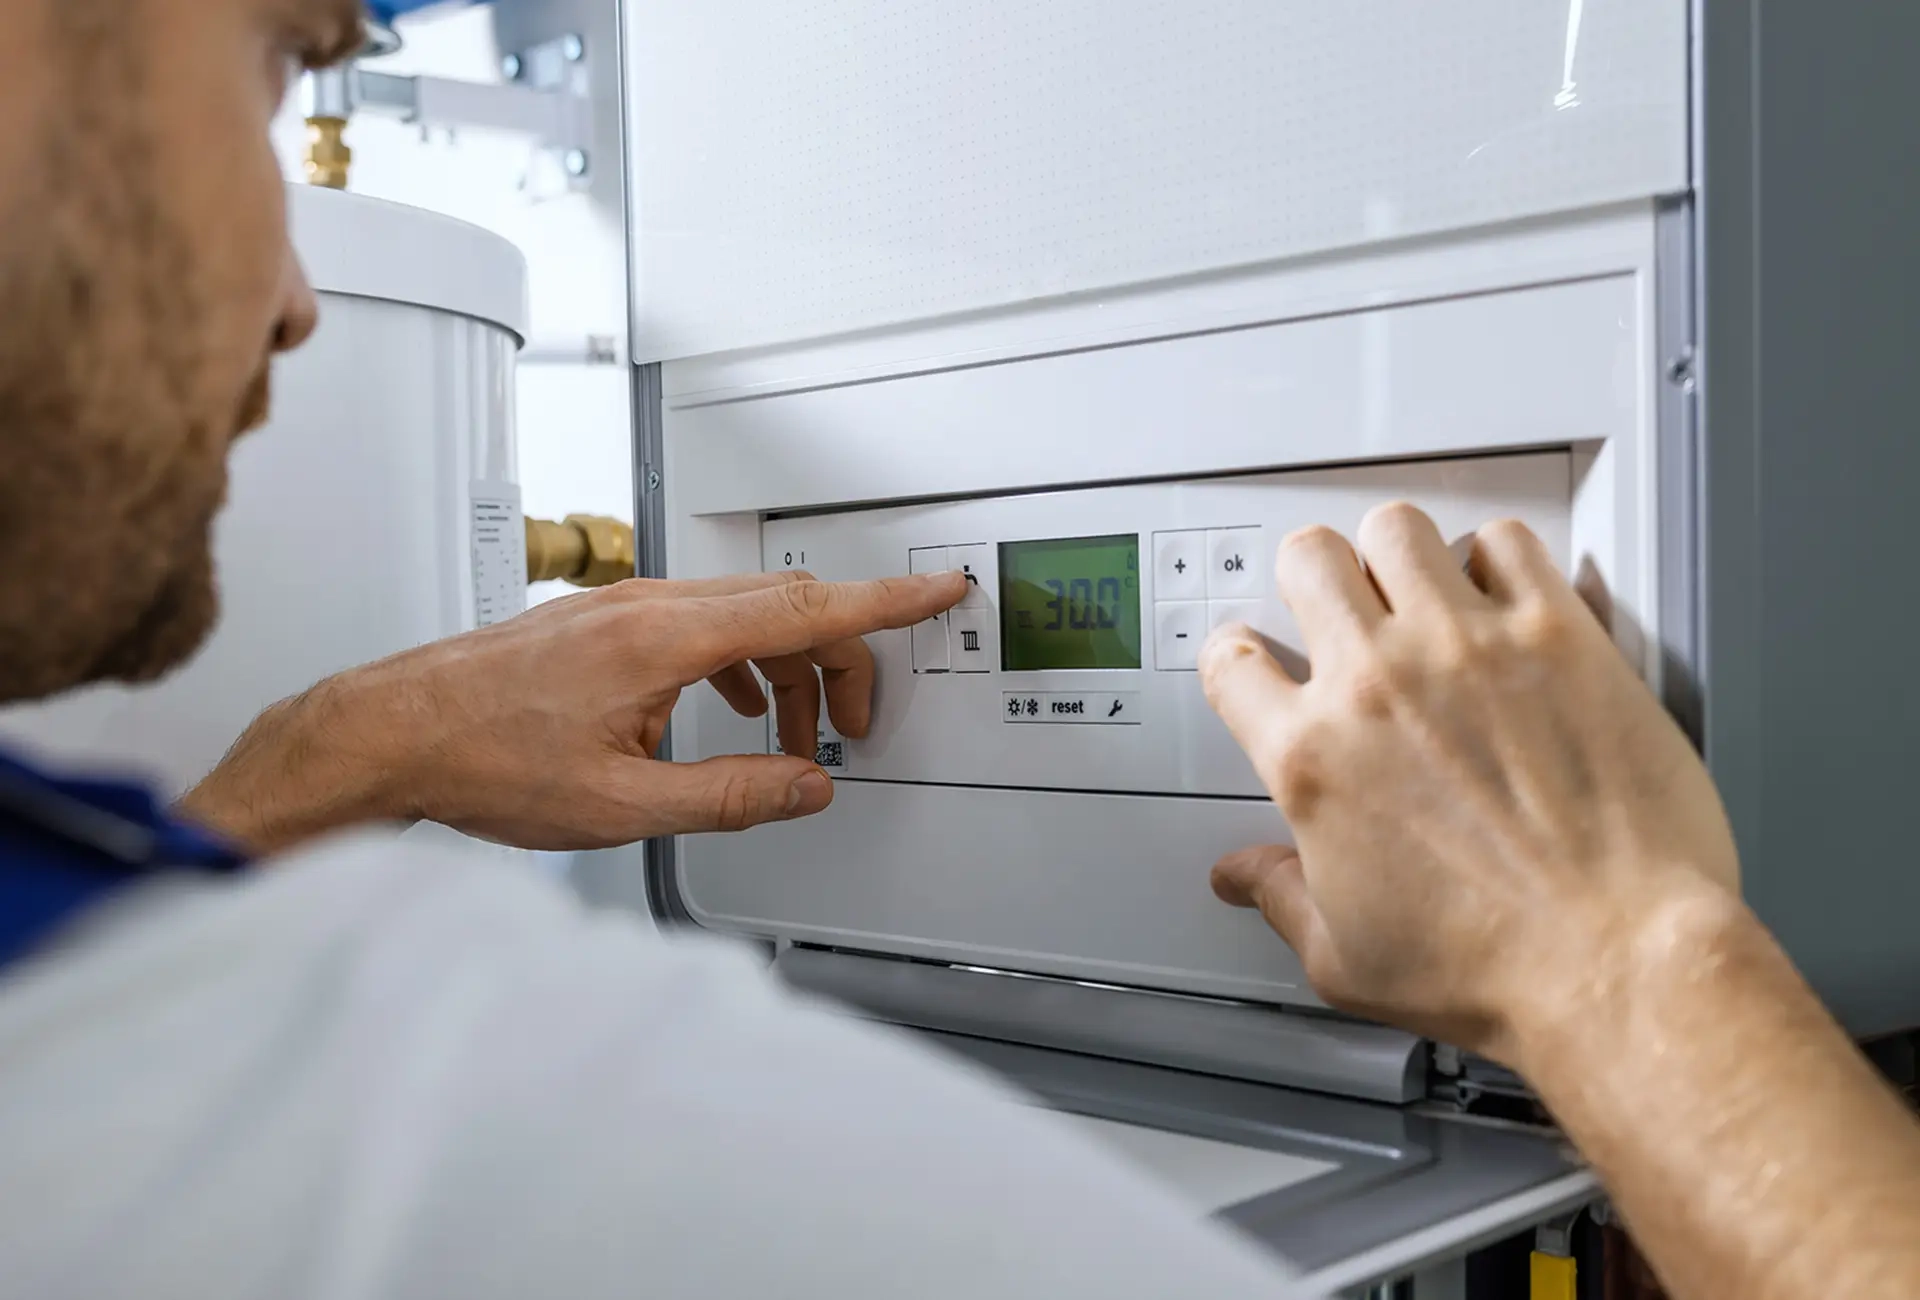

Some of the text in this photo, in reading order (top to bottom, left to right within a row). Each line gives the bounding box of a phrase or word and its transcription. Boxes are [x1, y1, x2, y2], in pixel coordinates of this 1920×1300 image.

[1224, 554, 1245, 572] ok
[1044, 577, 1121, 631] 30.0
[1051, 700, 1084, 714] reset
